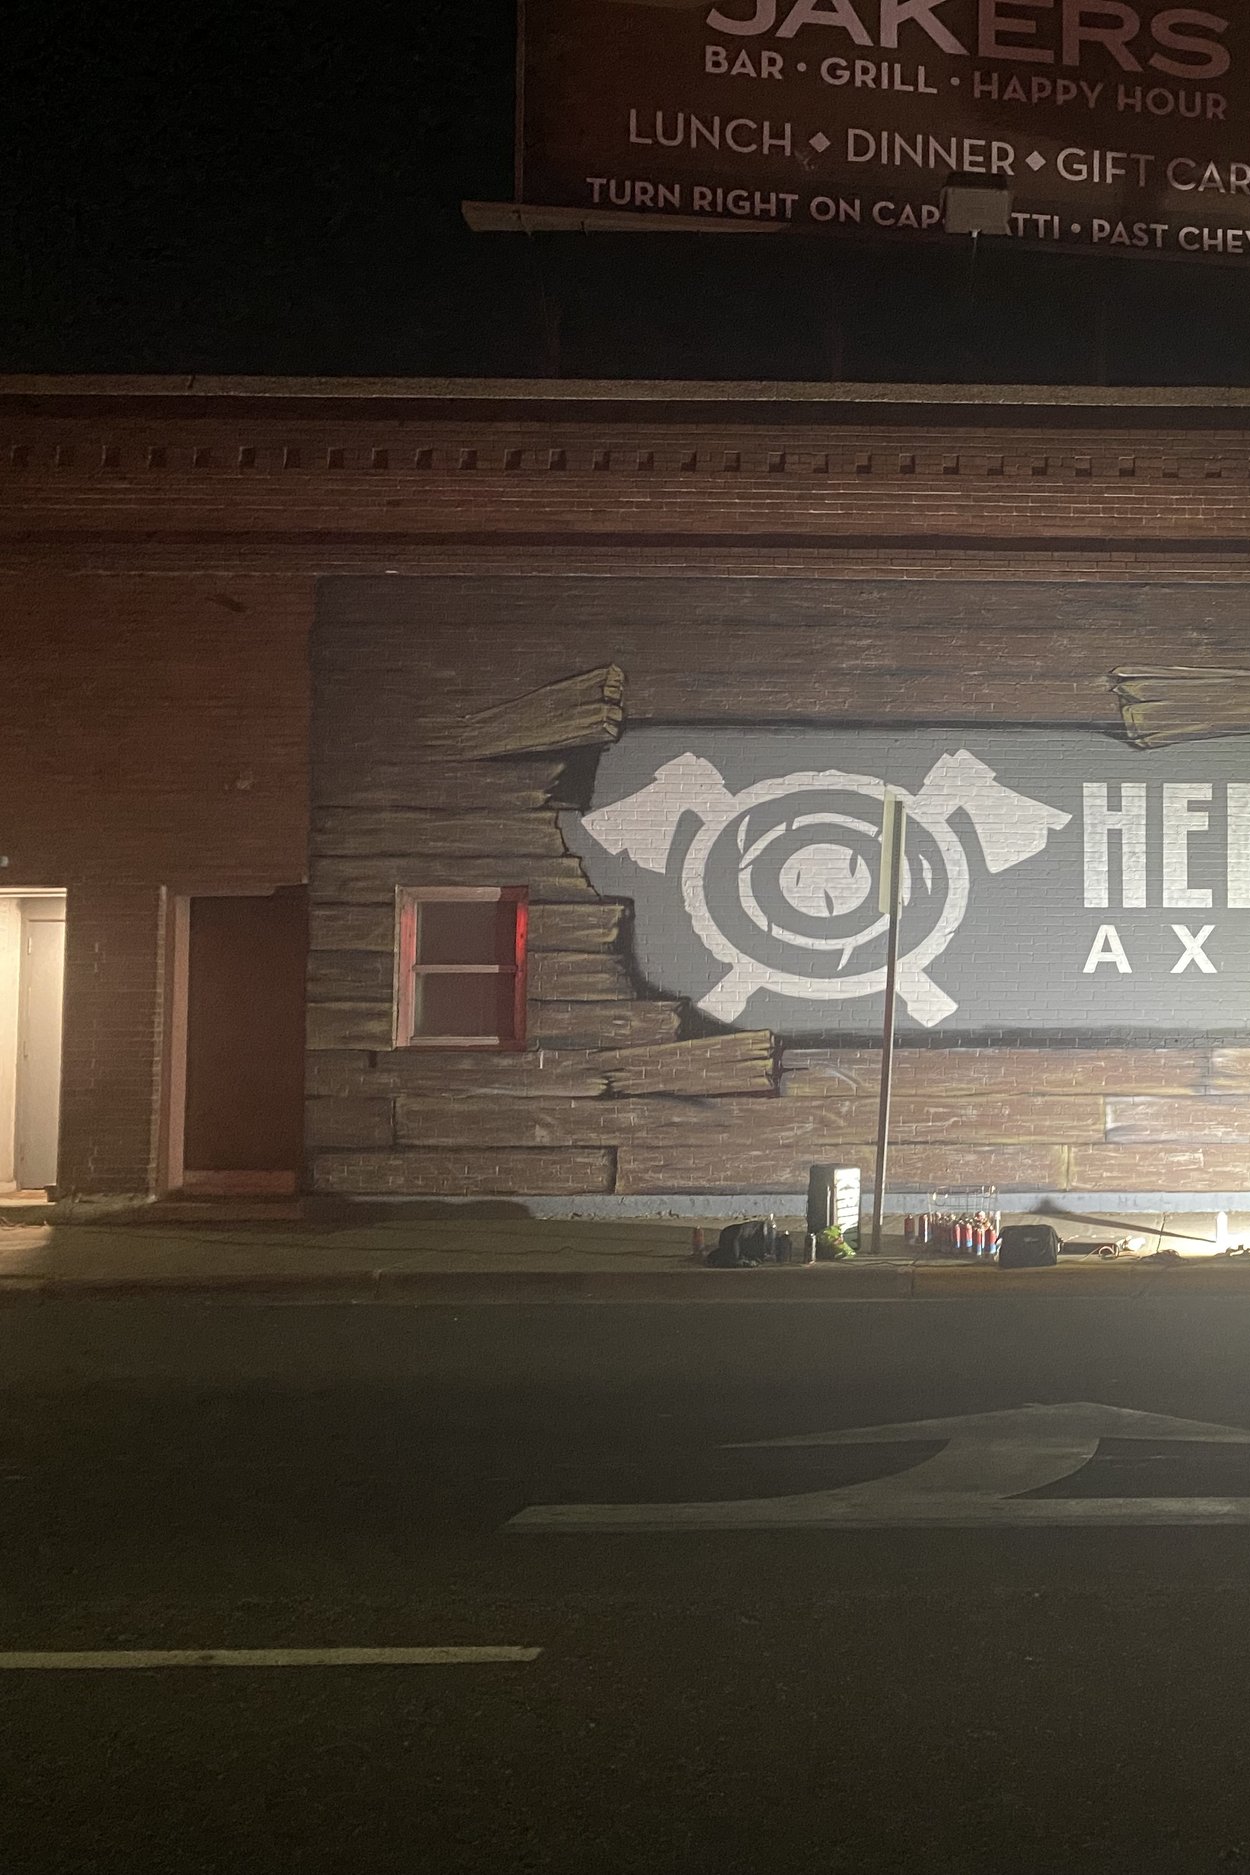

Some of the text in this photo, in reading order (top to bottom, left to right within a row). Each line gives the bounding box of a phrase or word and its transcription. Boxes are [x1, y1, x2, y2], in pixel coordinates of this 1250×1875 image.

[705, 45, 1228, 120] BAR GRILL HAPPY HOUR
[629, 108, 792, 157] LUNCH
[847, 129, 1015, 176] DINNER
[1056, 147, 1155, 188] GIFT
[585, 177, 681, 209] TURN
[693, 186, 799, 218] RIGHT
[809, 195, 861, 224] ON
[1092, 218, 1169, 248] PAST
